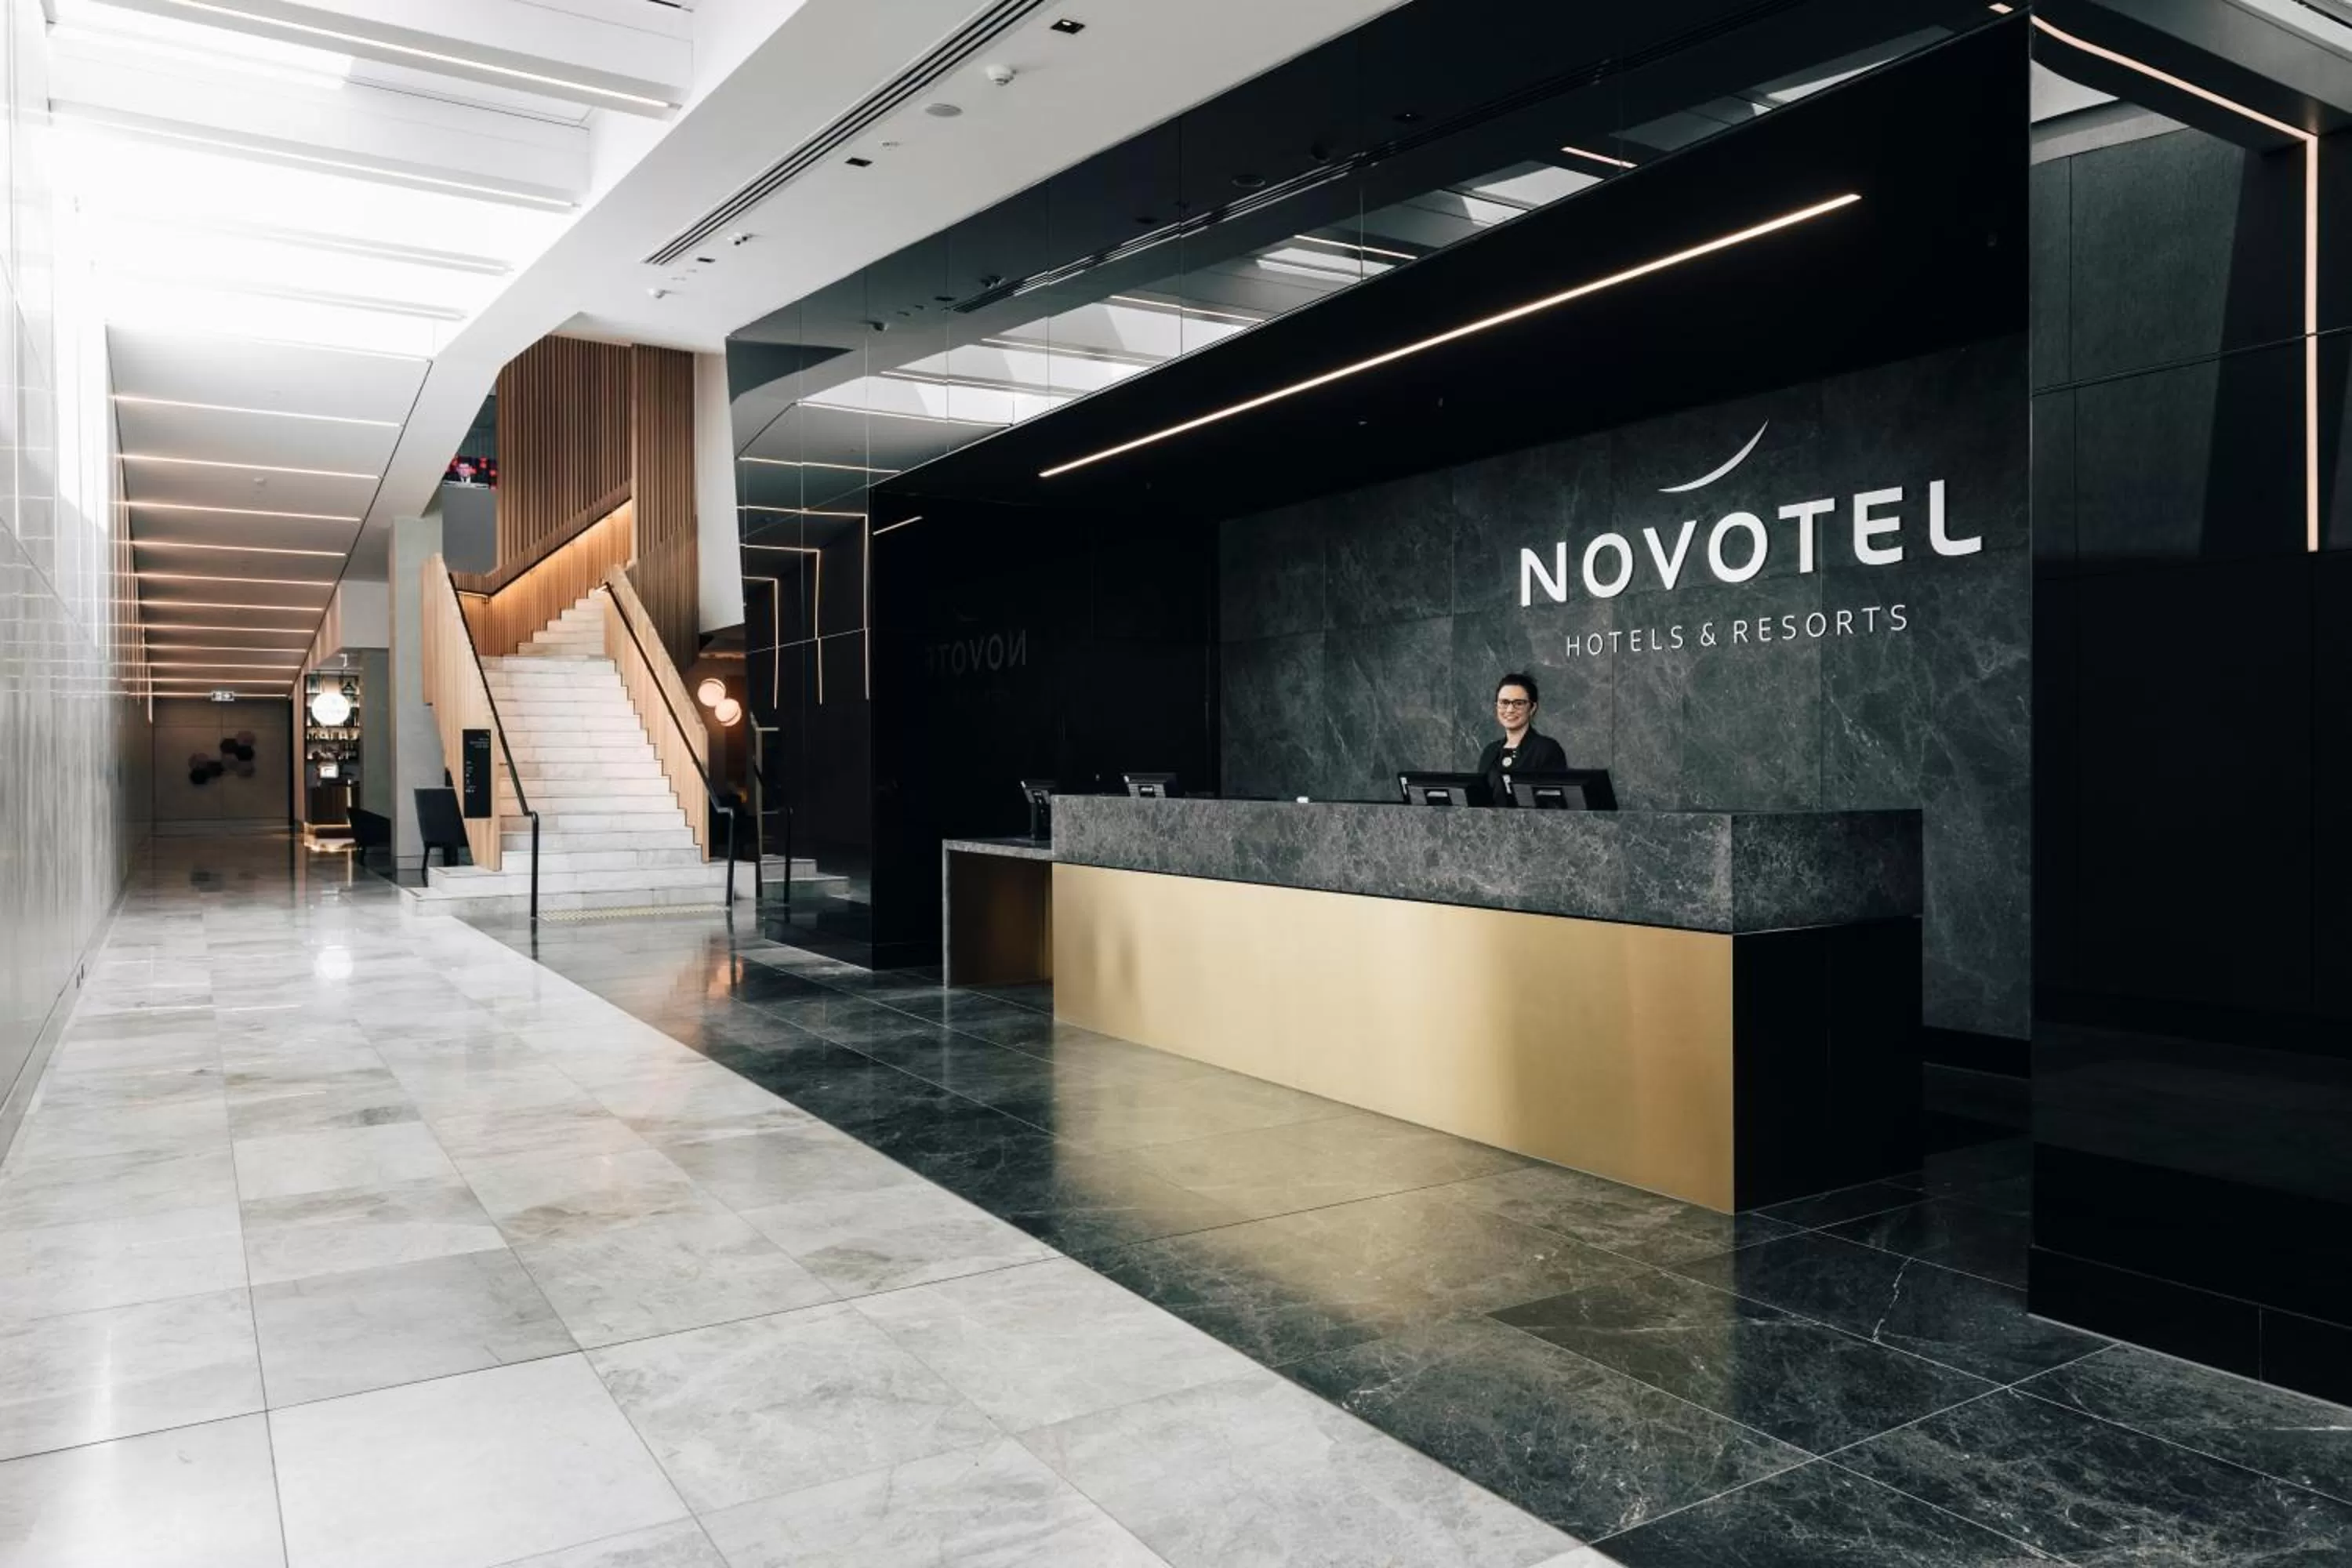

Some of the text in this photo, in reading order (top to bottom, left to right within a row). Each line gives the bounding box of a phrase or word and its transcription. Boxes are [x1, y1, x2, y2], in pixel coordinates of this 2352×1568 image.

[1520, 479, 1982, 608] NOVOTEL
[1566, 604, 1908, 658] HOTELS & RESORTS
